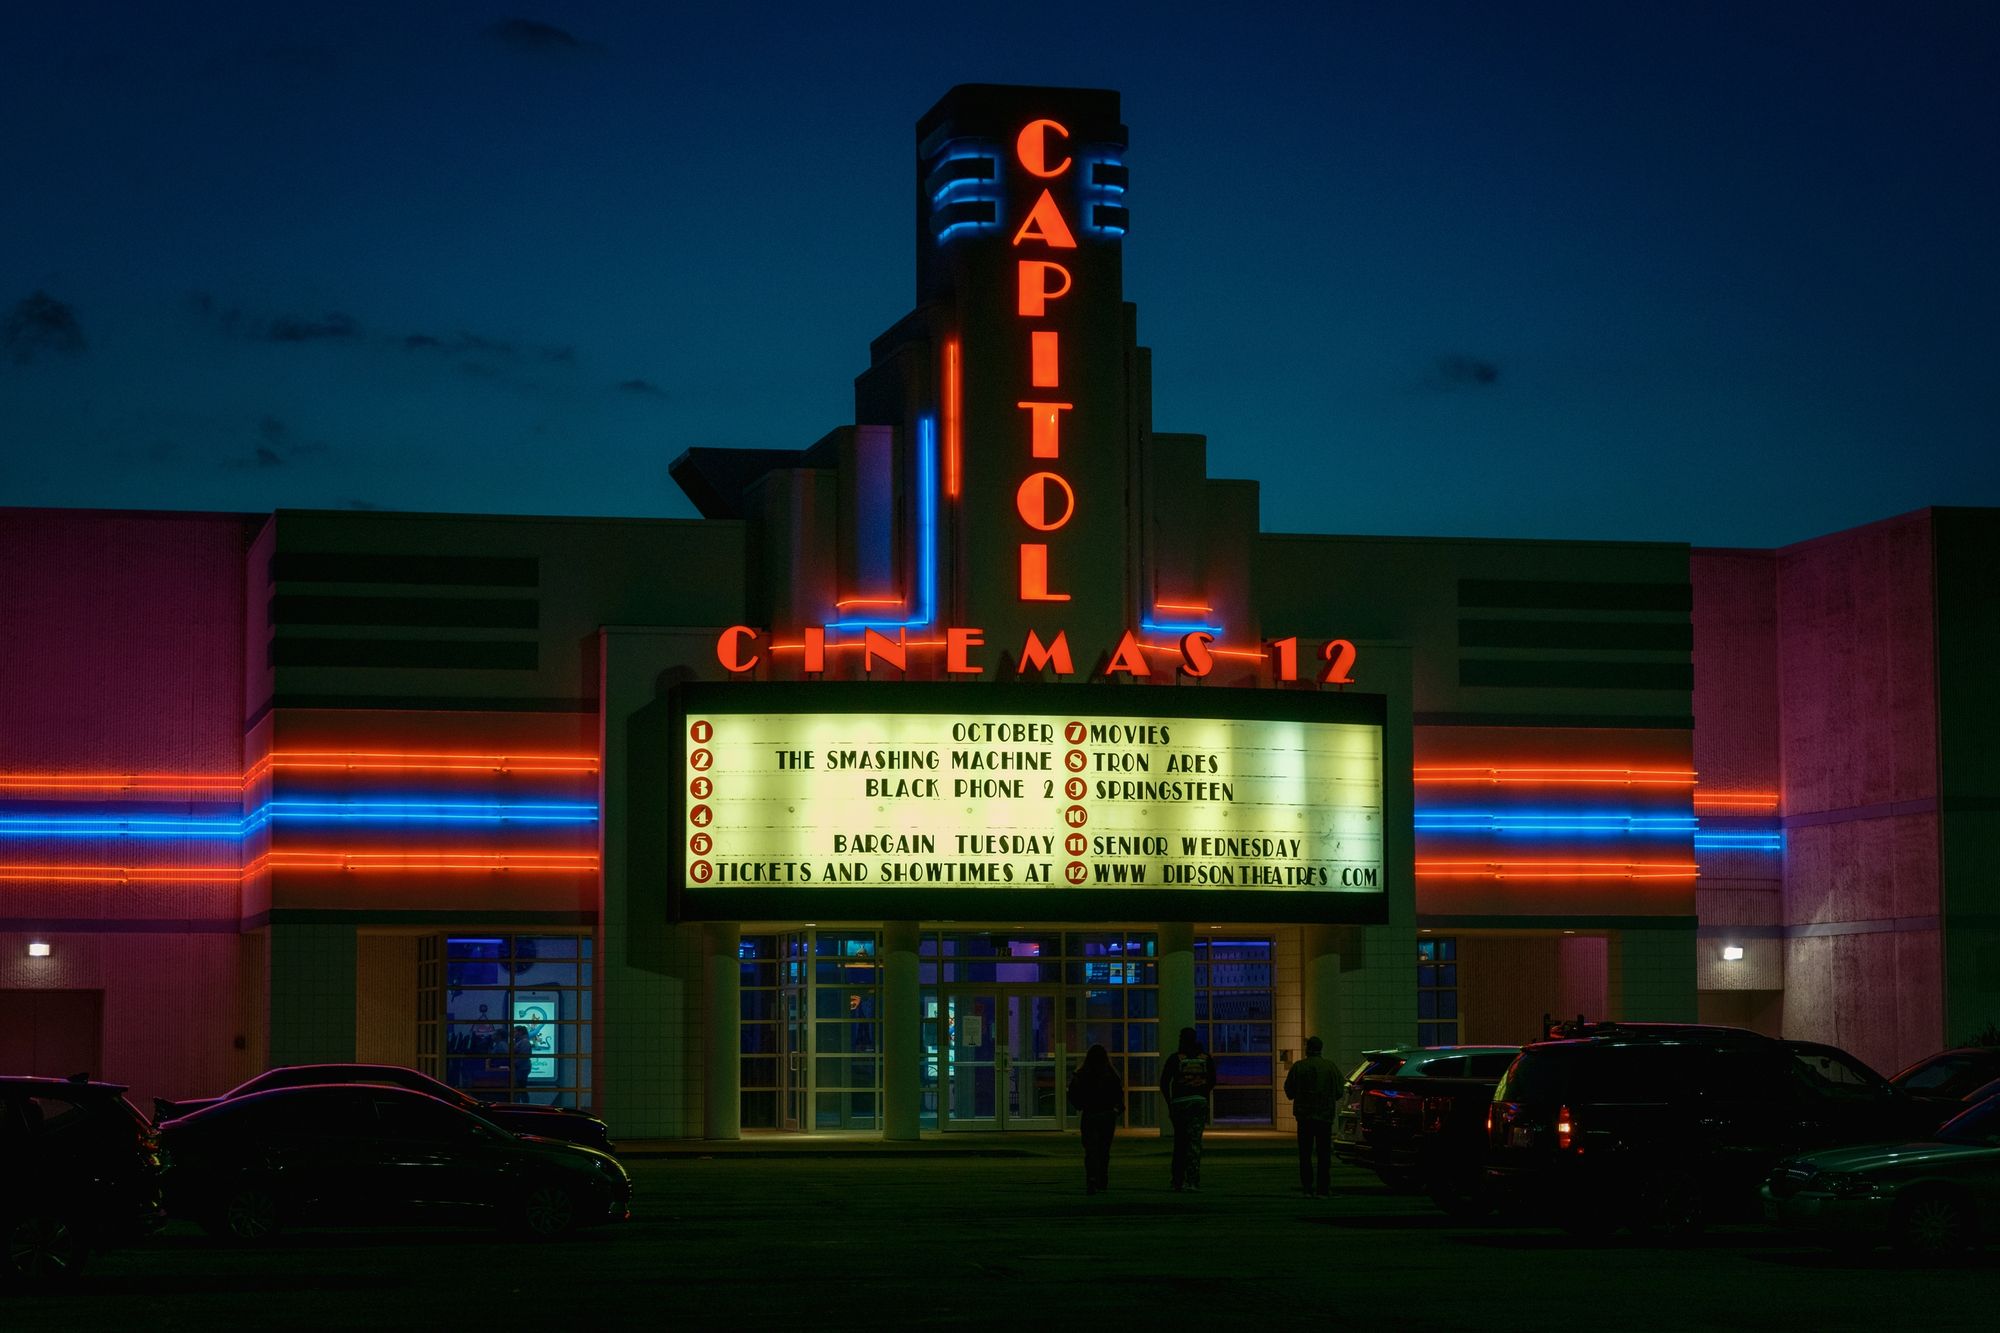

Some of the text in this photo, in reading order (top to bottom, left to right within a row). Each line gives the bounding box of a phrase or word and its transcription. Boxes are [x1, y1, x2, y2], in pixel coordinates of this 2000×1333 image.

[1012, 118, 1077, 602] CAPITOL
[716, 625, 1357, 683] CINEMAS 12
[952, 723, 1054, 743] OCTOBER
[1090, 724, 1170, 745] MOVIES
[775, 750, 815, 770] THE
[826, 750, 940, 770] SMASHING
[951, 751, 1052, 770] MACHINE
[1093, 752, 1149, 772] TRON
[1167, 754, 1219, 773] ARES
[865, 778, 940, 797] BLACK
[954, 779, 1025, 798] PHONE
[1043, 780, 1054, 799] 2
[1096, 780, 1234, 801] SPRINGSTEEN
[834, 834, 935, 854] BARGAIN
[954, 835, 1055, 854] TUESDAY
[1093, 836, 1169, 856] SENIOR
[1182, 837, 1302, 858] WEDNESDAY
[716, 862, 811, 882] TICKETS
[823, 863, 868, 882] AND
[880, 863, 1014, 882] SHOWTIMES
[1025, 863, 1052, 882] AT
[1094, 863, 1147, 883] WWW
[1342, 868, 1378, 887] COM
